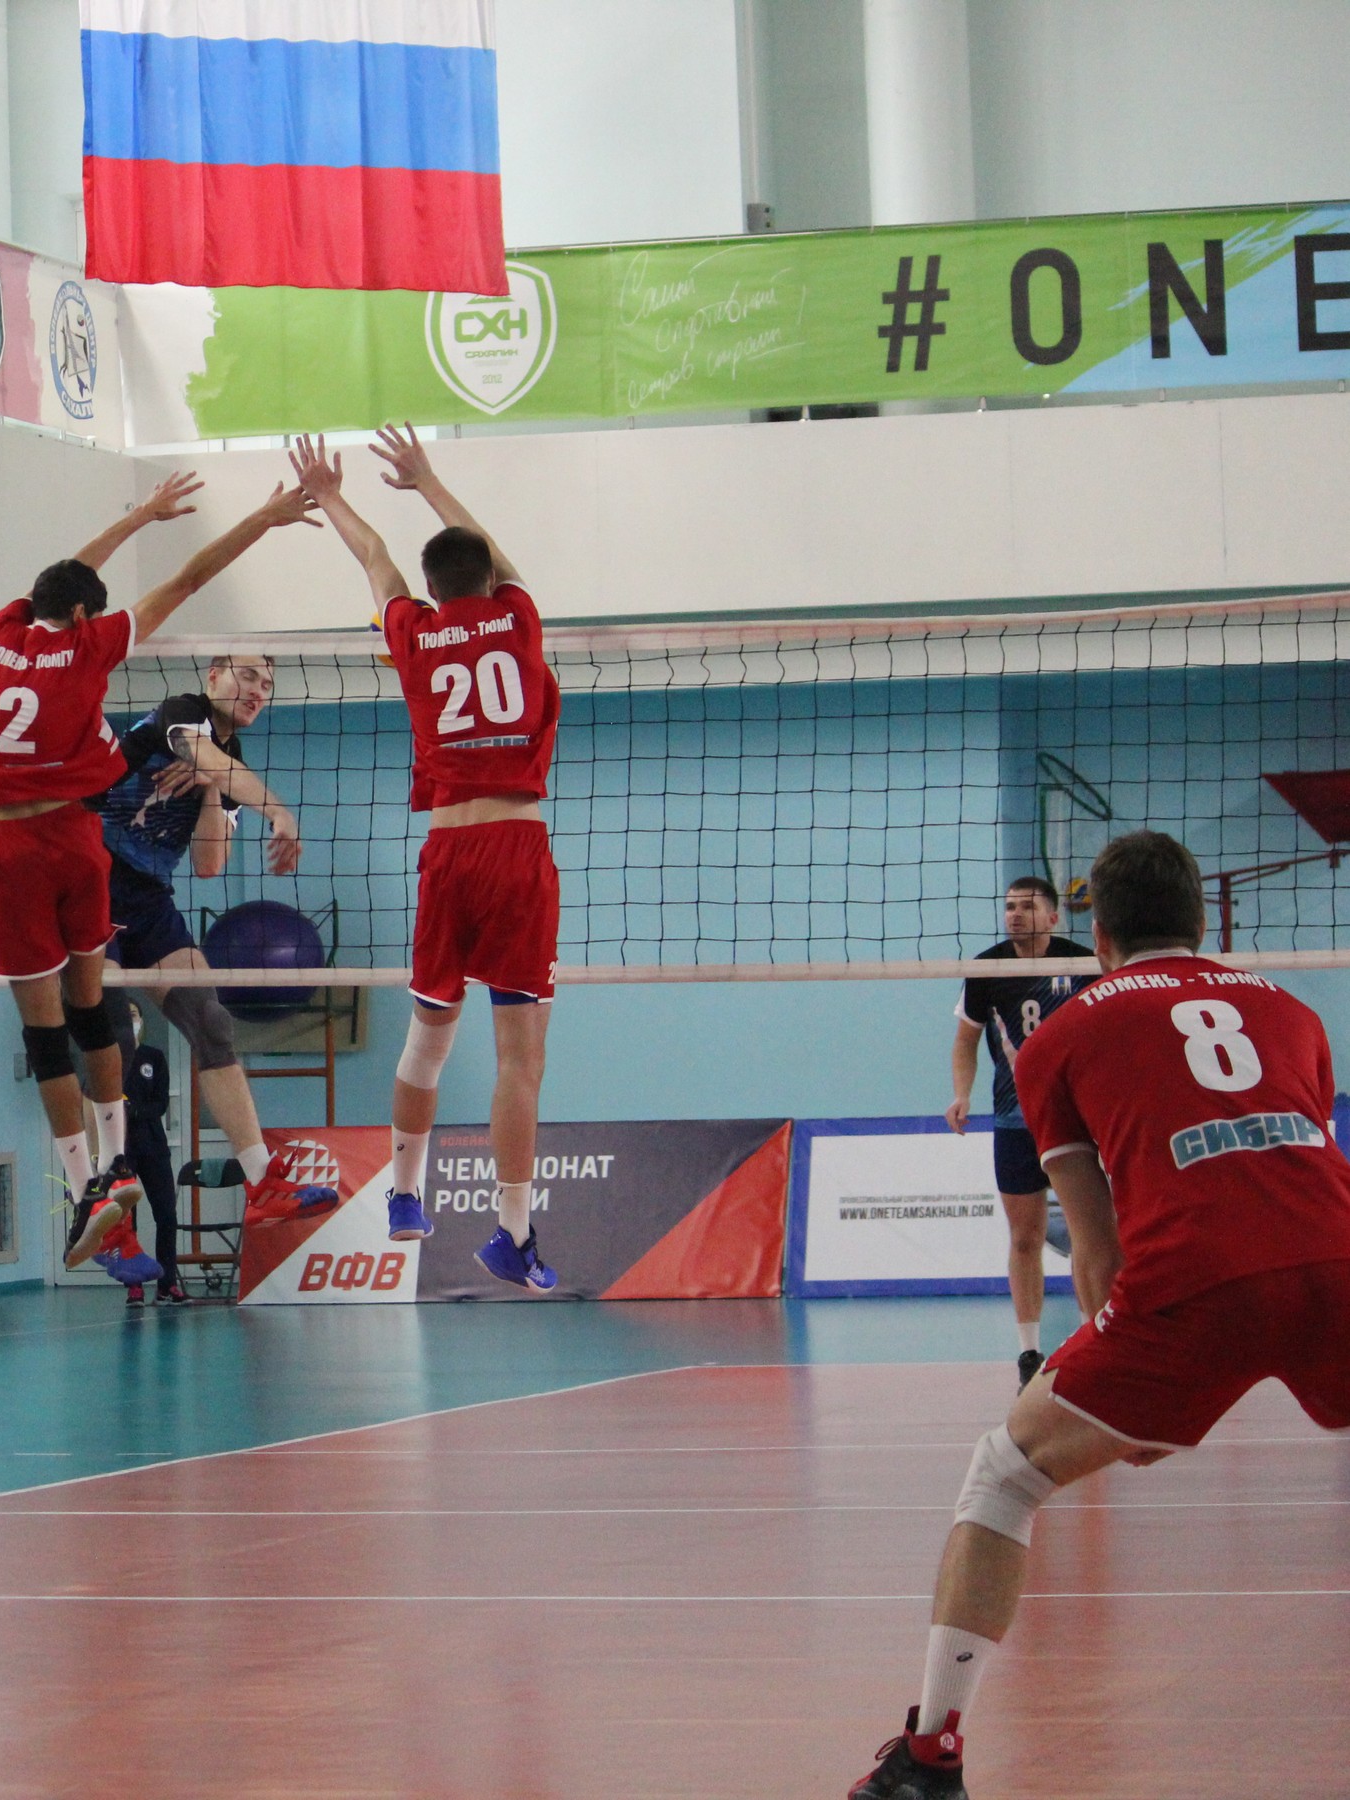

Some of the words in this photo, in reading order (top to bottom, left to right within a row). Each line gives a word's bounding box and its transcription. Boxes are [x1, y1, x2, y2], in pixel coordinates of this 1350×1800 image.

[878, 233, 1350, 374] #ONE
[482, 374, 503, 385] 2012
[417, 625, 469, 650] ТЮМЕНЬ
[430, 650, 525, 735] 20
[1077, 973, 1181, 1007] ТЮМЕНЬ
[1021, 1000, 1041, 1037] 8
[1171, 999, 1263, 1092] 8
[1172, 1113, 1326, 1169] СИБУР
[839, 1204, 994, 1220] WWW.ONETEAMSAKHALIN.COM
[298, 1251, 406, 1292] ВФВ
